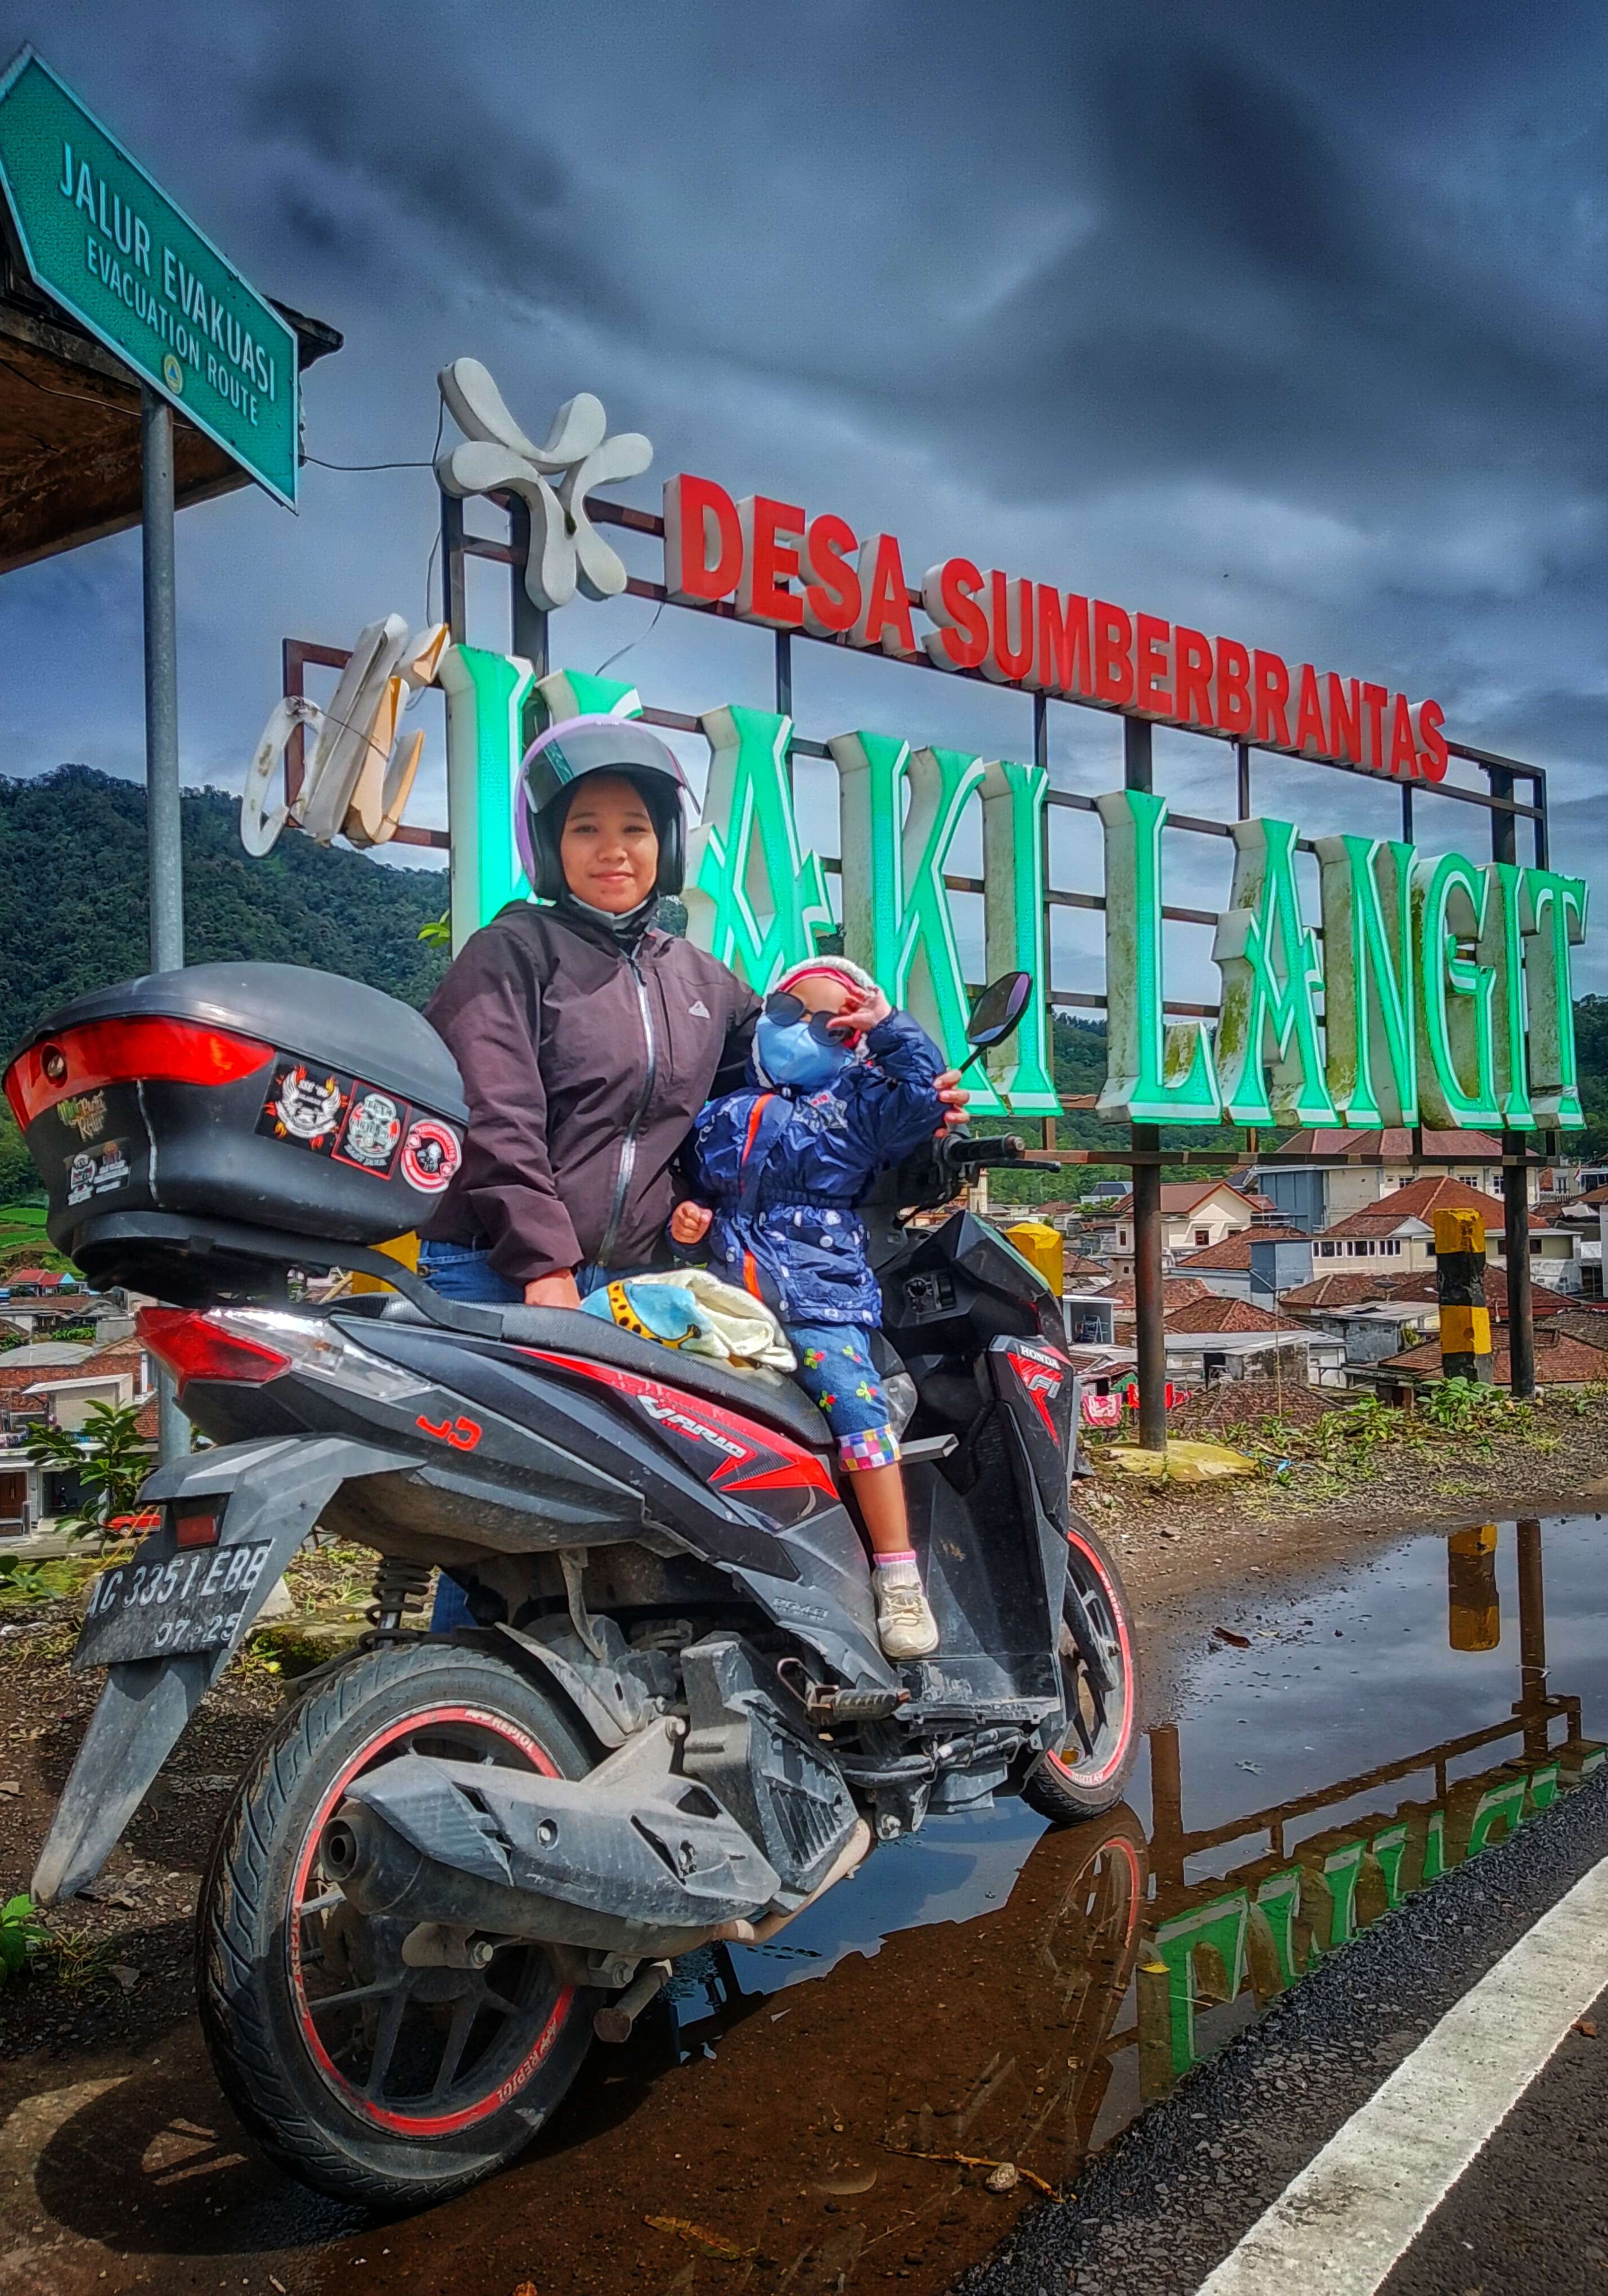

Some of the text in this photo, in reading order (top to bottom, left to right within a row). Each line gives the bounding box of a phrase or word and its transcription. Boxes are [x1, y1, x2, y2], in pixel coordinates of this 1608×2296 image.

[60, 142, 275, 402] JALUR EVAKUASI
[87, 234, 258, 427] EVACUATION ROUTE
[664, 472, 1449, 783] DESA SUMBERBRANTAS
[1097, 789, 1588, 1131] LANGIT
[1019, 1344, 1062, 1370] HONDA
[1028, 1374, 1061, 1399] FI
[636, 1394, 748, 1459] VARIO
[122, 1555, 200, 1608] 3351
[200, 1546, 270, 1597] EBB
